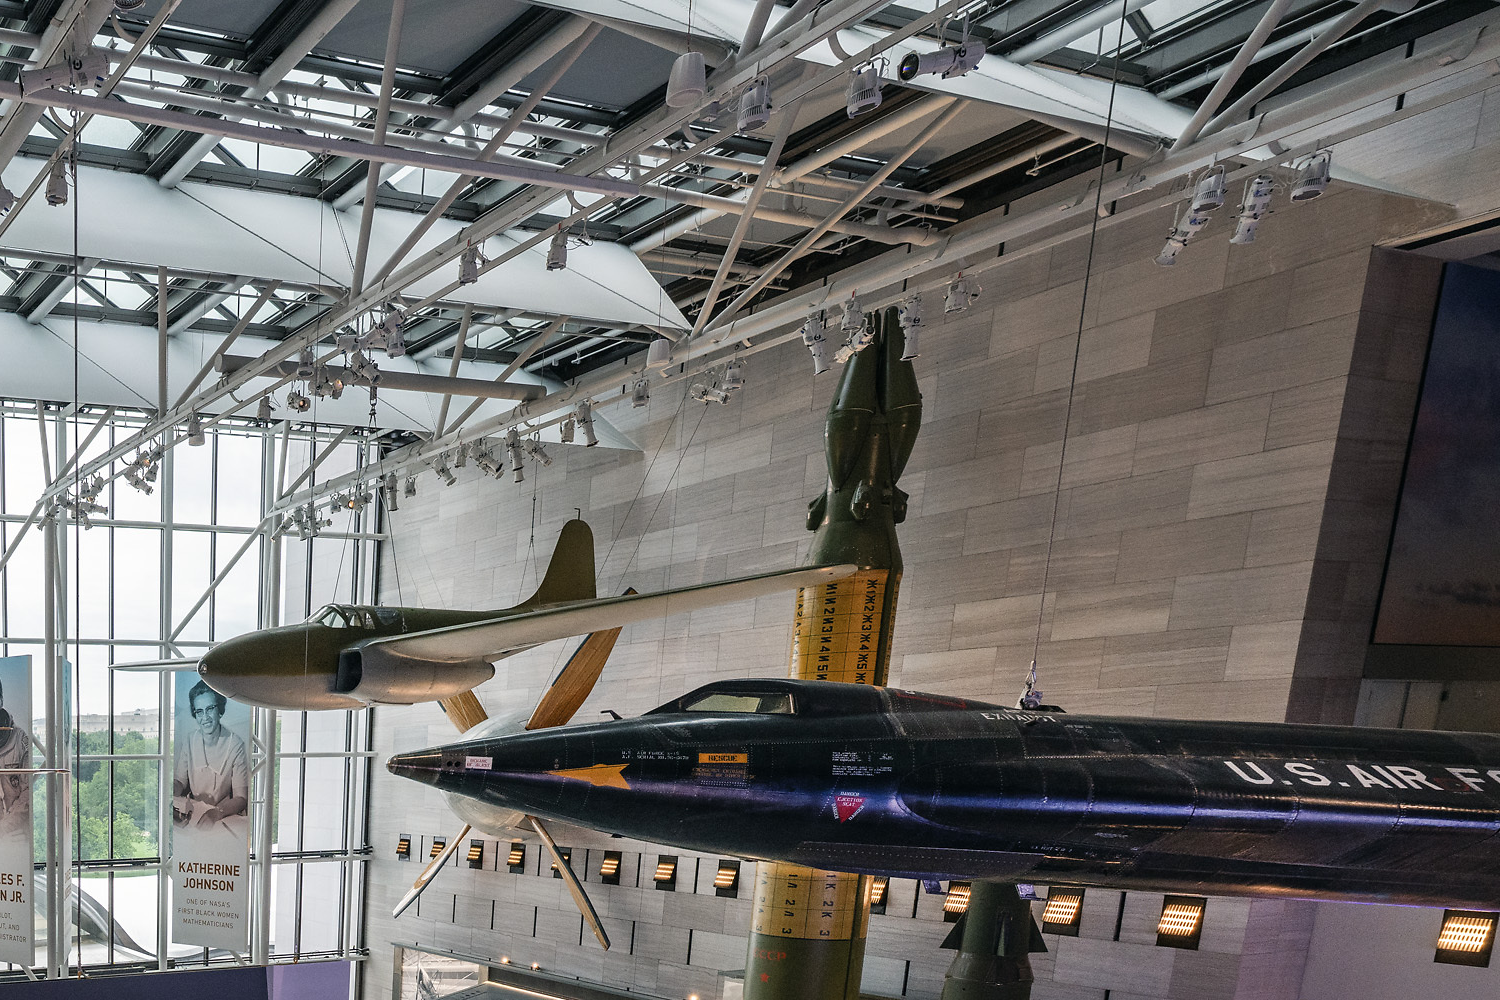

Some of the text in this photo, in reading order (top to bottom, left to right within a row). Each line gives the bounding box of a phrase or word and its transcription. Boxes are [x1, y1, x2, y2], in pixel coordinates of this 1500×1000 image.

[1224, 761, 1350, 788] U.S.
[1346, 764, 1444, 790] AIR
[178, 862, 240, 876] KATHERINE
[16, 874, 24, 886] F.
[183, 878, 234, 892] JOHNSON
[10, 891, 25, 903] JR.
[183, 918, 234, 929] MATHEMATICIANS
